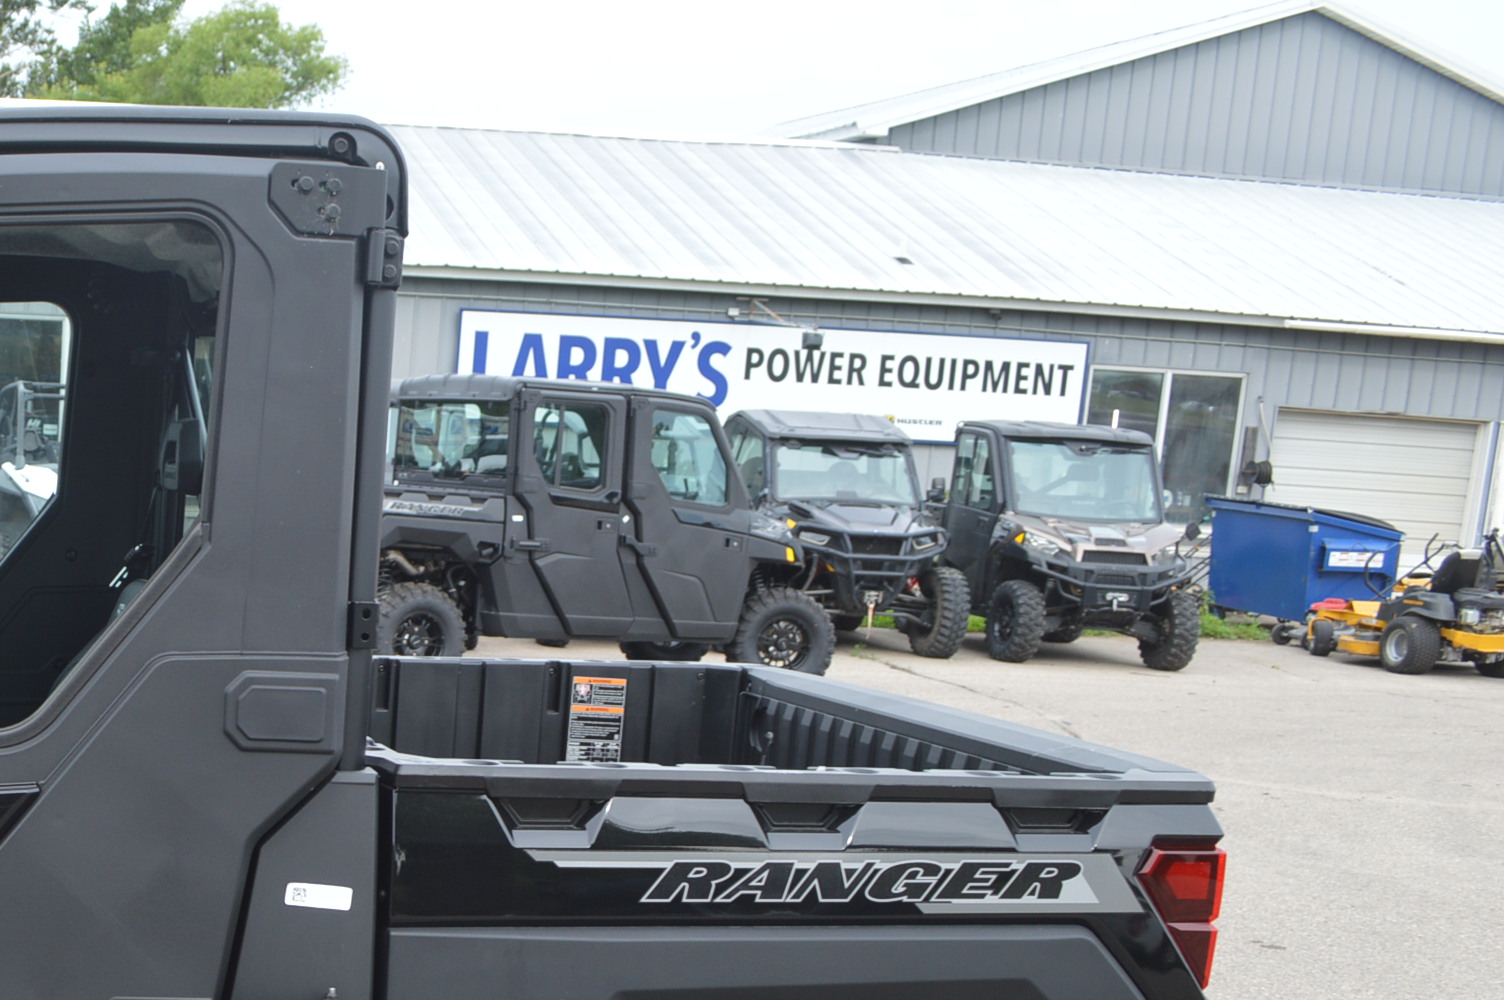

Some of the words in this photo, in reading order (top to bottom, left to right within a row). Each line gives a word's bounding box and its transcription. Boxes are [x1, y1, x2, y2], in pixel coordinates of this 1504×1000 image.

[744, 347, 868, 387] POWER
[878, 354, 1075, 397] EQUIPMENT
[639, 859, 1084, 903] RANGER
